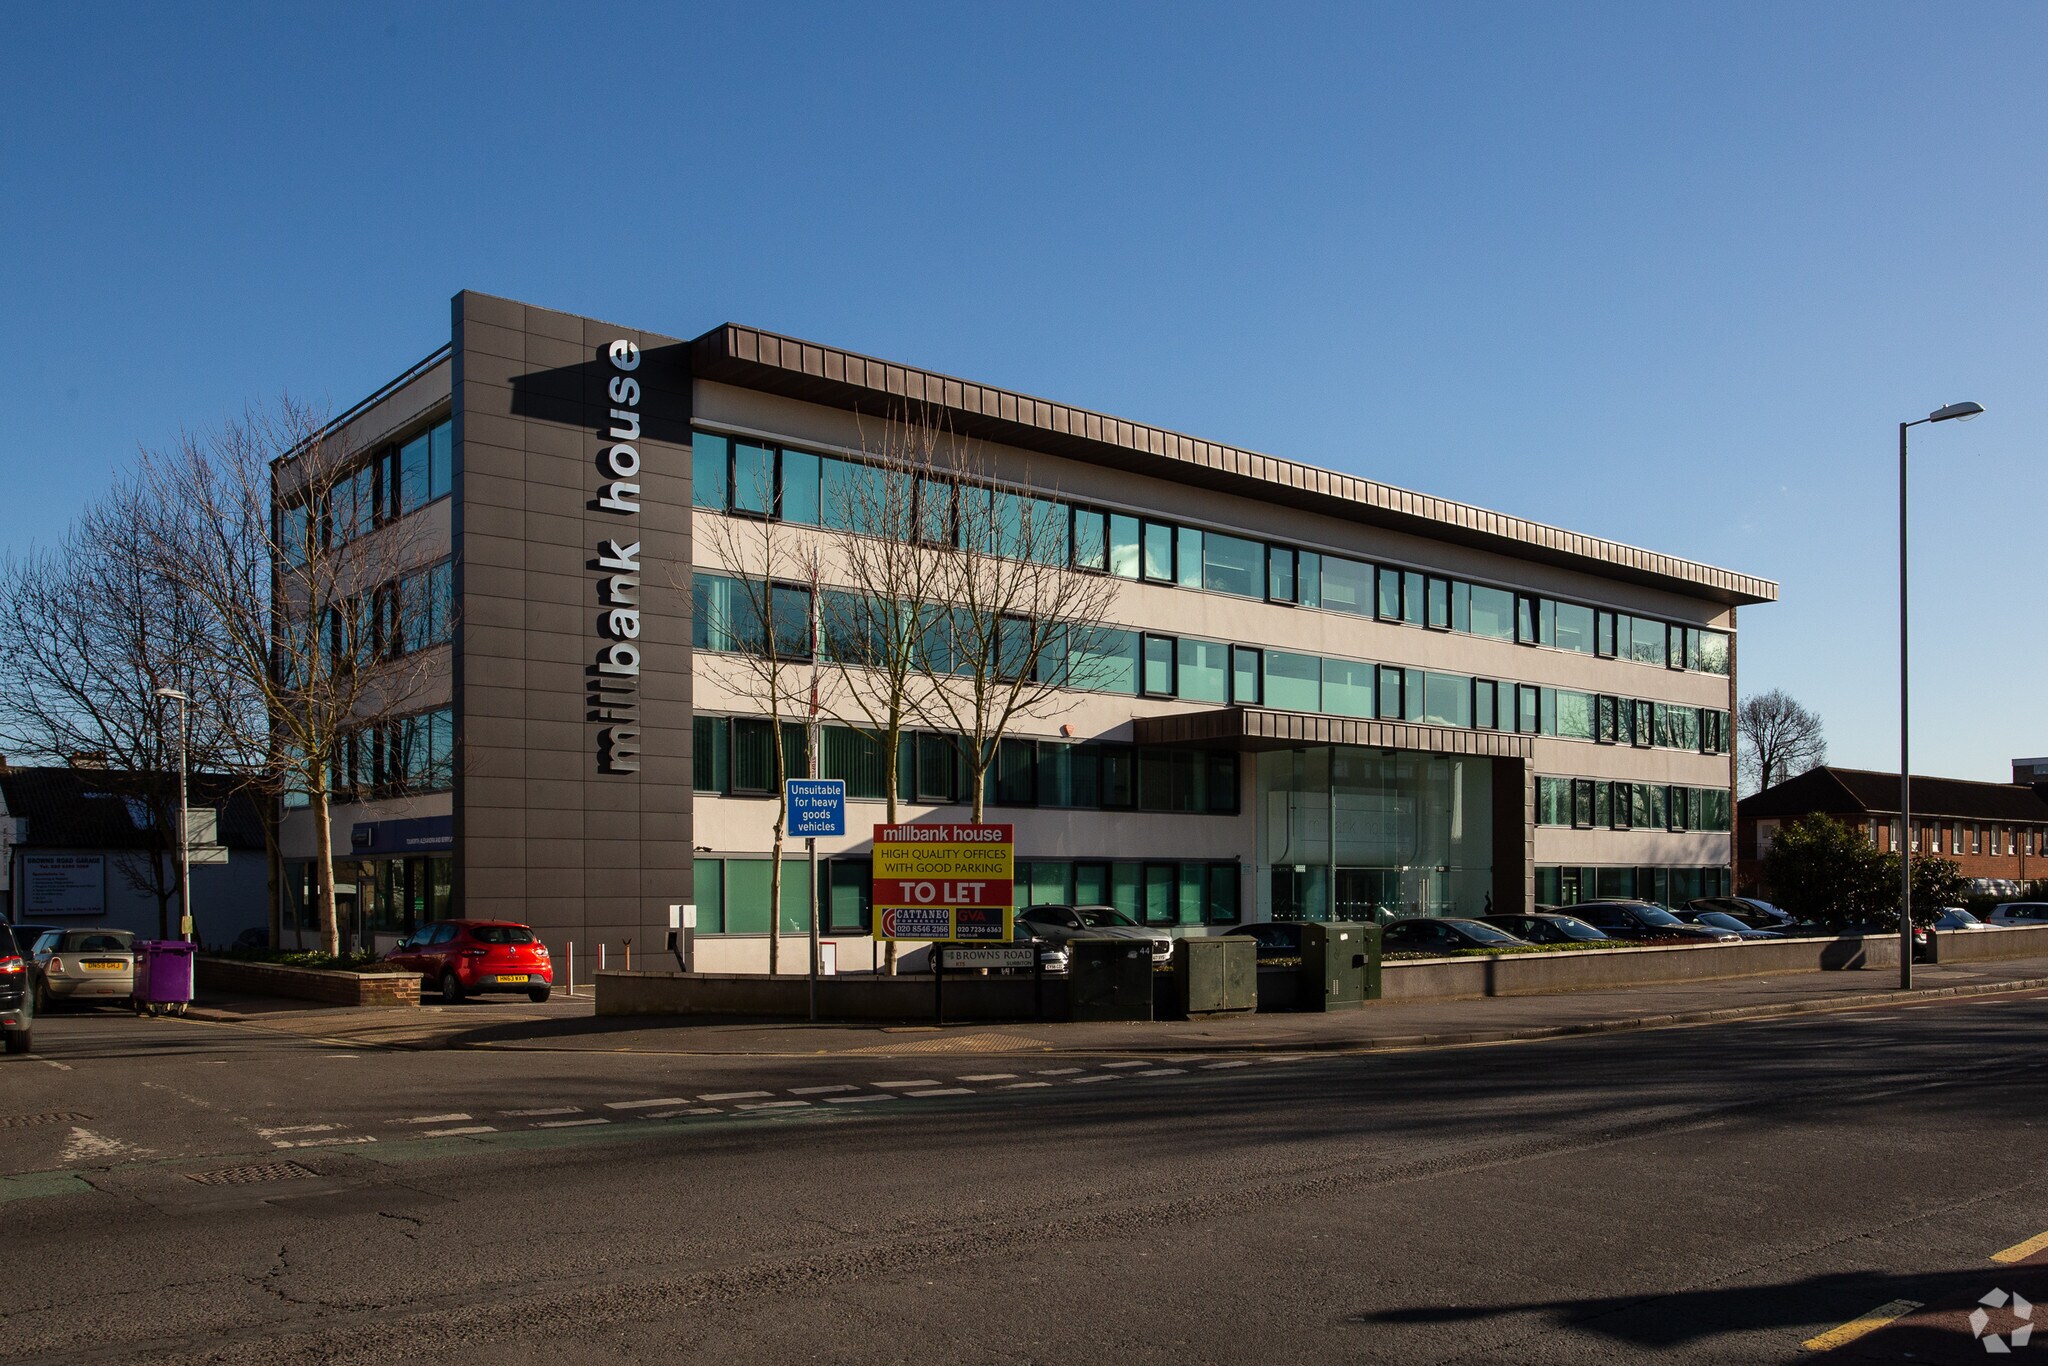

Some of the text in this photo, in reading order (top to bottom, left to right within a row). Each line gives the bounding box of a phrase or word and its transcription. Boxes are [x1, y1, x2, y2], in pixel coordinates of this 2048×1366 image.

[599, 339, 641, 772] millbank house
[791, 784, 841, 795] Unsuitable
[794, 797, 838, 809] for heavy
[802, 809, 831, 821] goods
[798, 822, 836, 832] vehicles
[884, 826, 1002, 842] millbank house
[881, 849, 1006, 860] HIGH QUALITY OFFICES
[885, 863, 1003, 873] WITH GOOD PARKING
[899, 881, 986, 903] TO LET
[896, 909, 949, 919] CATTANEO
[957, 910, 986, 922] GVA
[956, 951, 1032, 959] BROWNS ROAD
